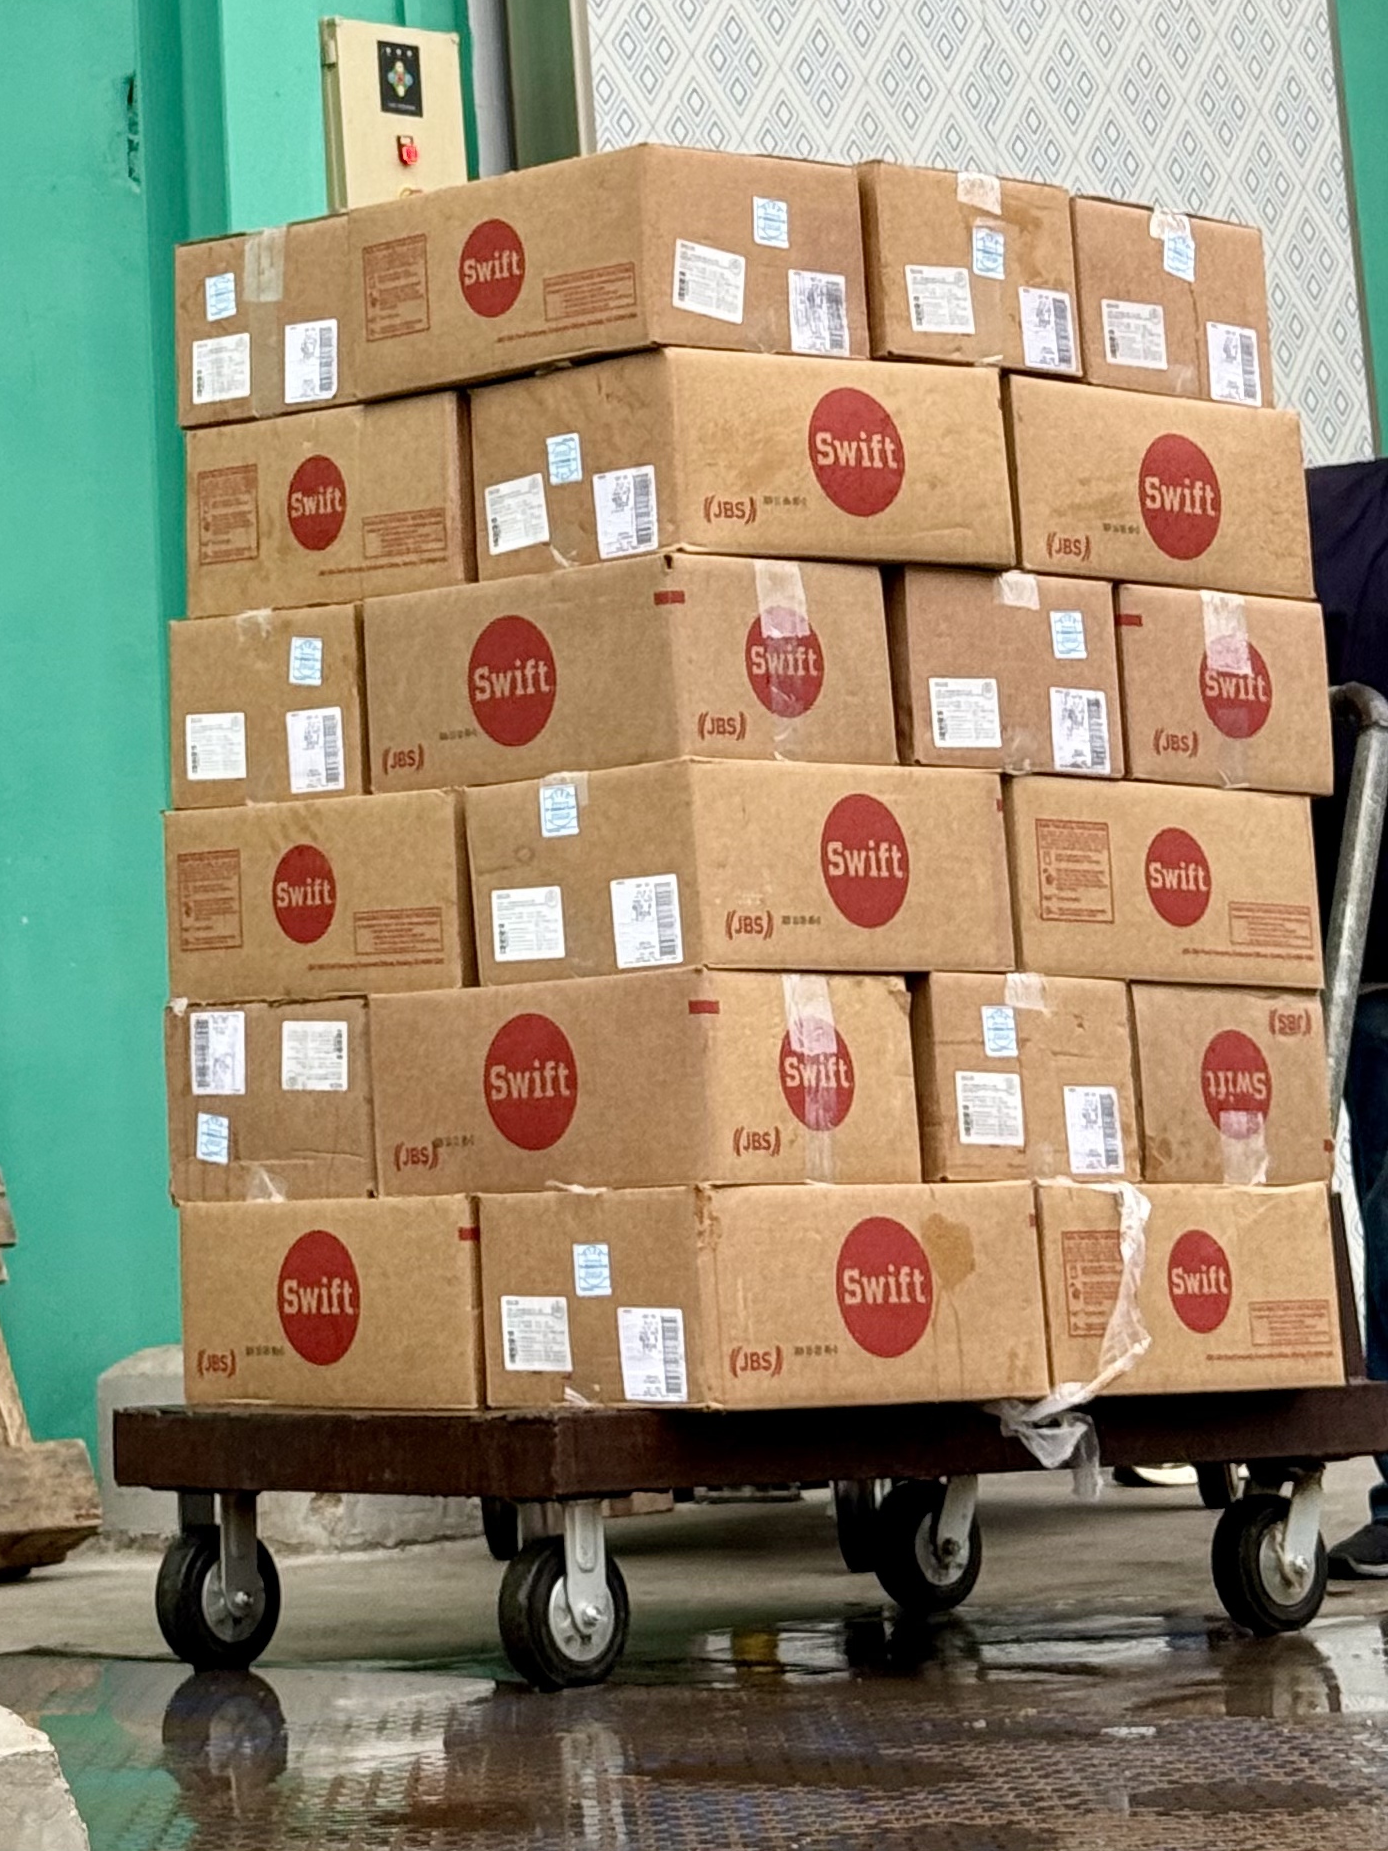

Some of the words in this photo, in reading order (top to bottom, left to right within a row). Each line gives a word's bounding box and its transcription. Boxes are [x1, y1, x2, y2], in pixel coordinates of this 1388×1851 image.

[463, 249, 522, 286] Swift
[815, 430, 898, 469] Swift
[290, 486, 344, 517] Swift
[1144, 476, 1216, 517] Swift
[751, 645, 818, 678] Swift
[474, 658, 551, 702] Swift
[1203, 671, 1269, 702] Swift
[826, 839, 904, 879] Swift
[1148, 860, 1209, 892] Swift
[276, 877, 333, 909] Swift
[489, 1058, 571, 1100] Swift
[784, 1053, 852, 1089] Swift
[1207, 1069, 1268, 1100] Swift
[283, 1276, 354, 1315] Swift
[843, 1264, 926, 1305] Swift
[1171, 1264, 1230, 1295] Swift
